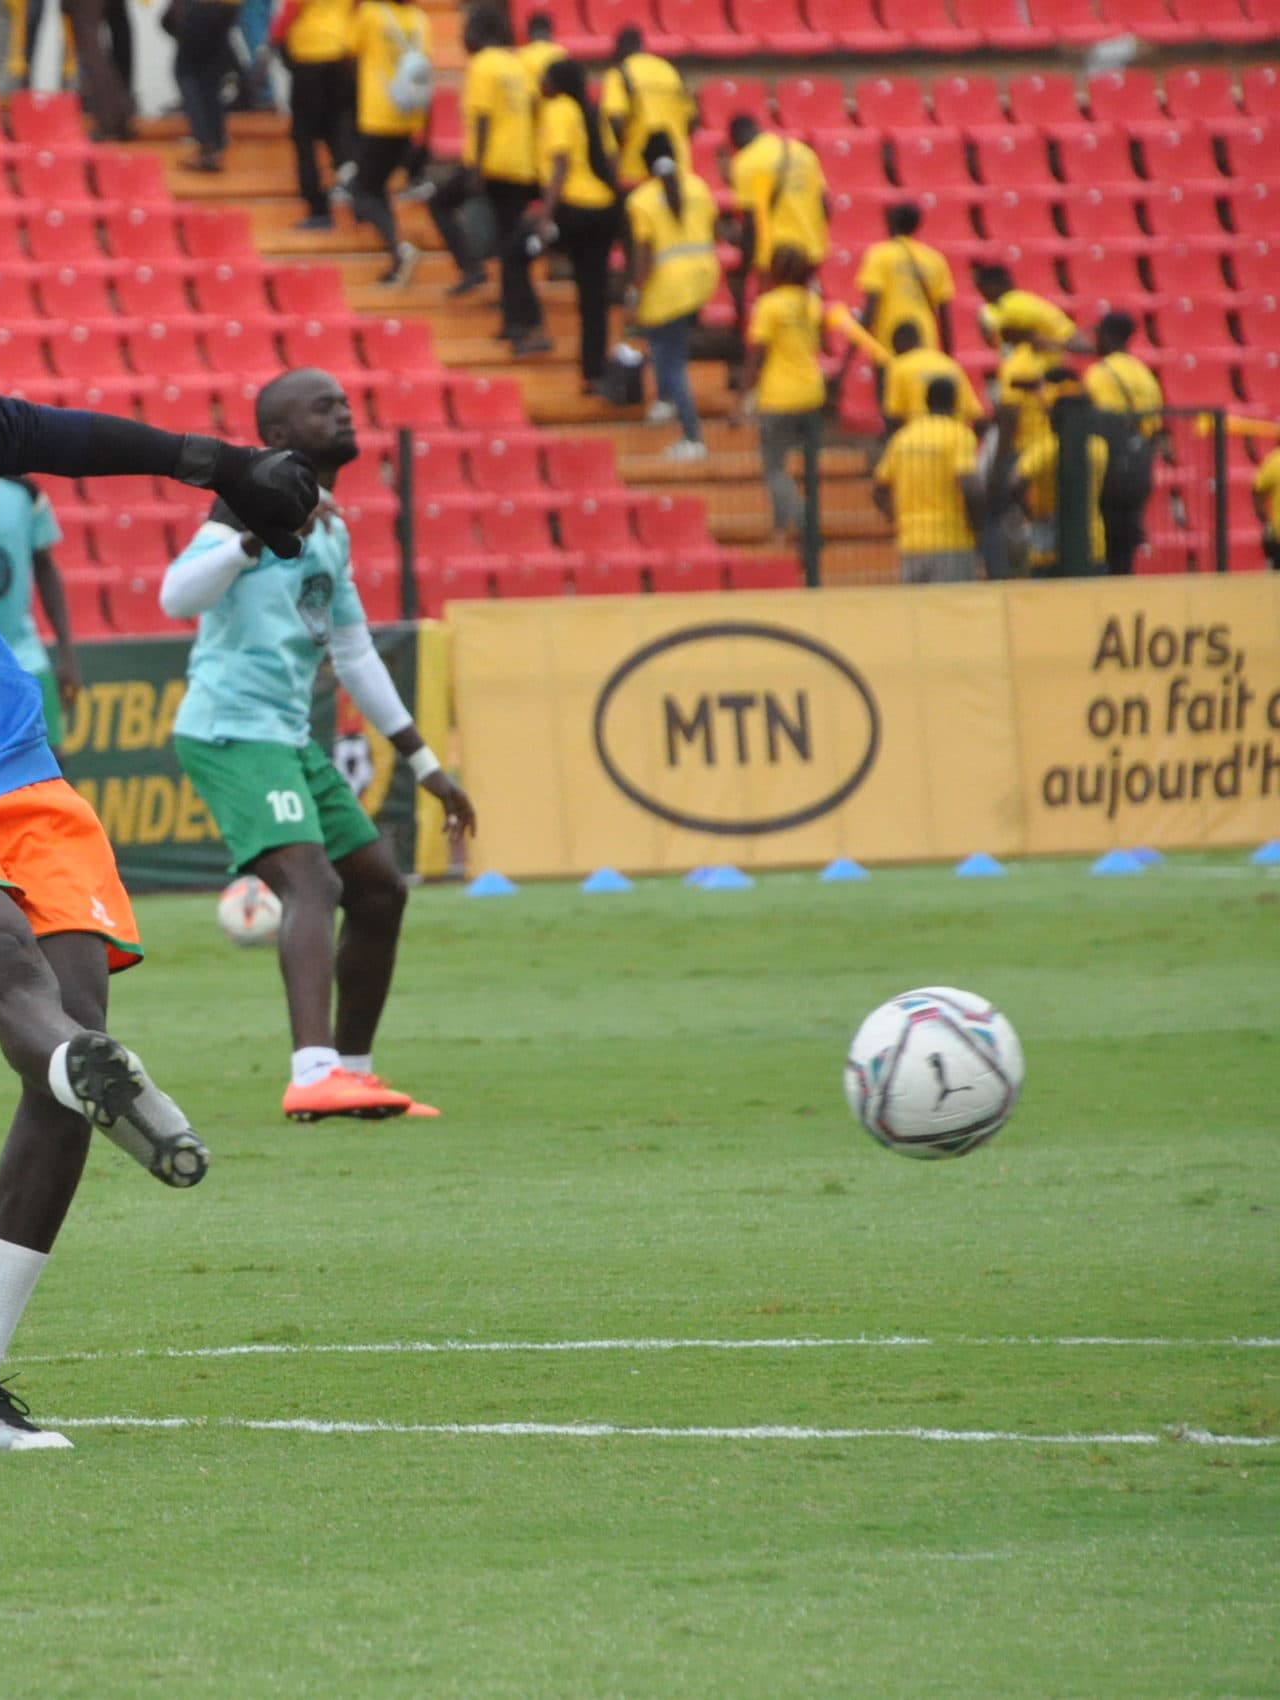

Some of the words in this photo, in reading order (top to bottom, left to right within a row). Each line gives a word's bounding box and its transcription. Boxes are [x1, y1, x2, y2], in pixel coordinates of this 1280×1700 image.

[1091, 611, 1244, 674] Alors,
[663, 690, 814, 767] MTN
[1087, 697, 1150, 737] on
[1166, 675, 1254, 733] fait
[266, 791, 303, 823] 10
